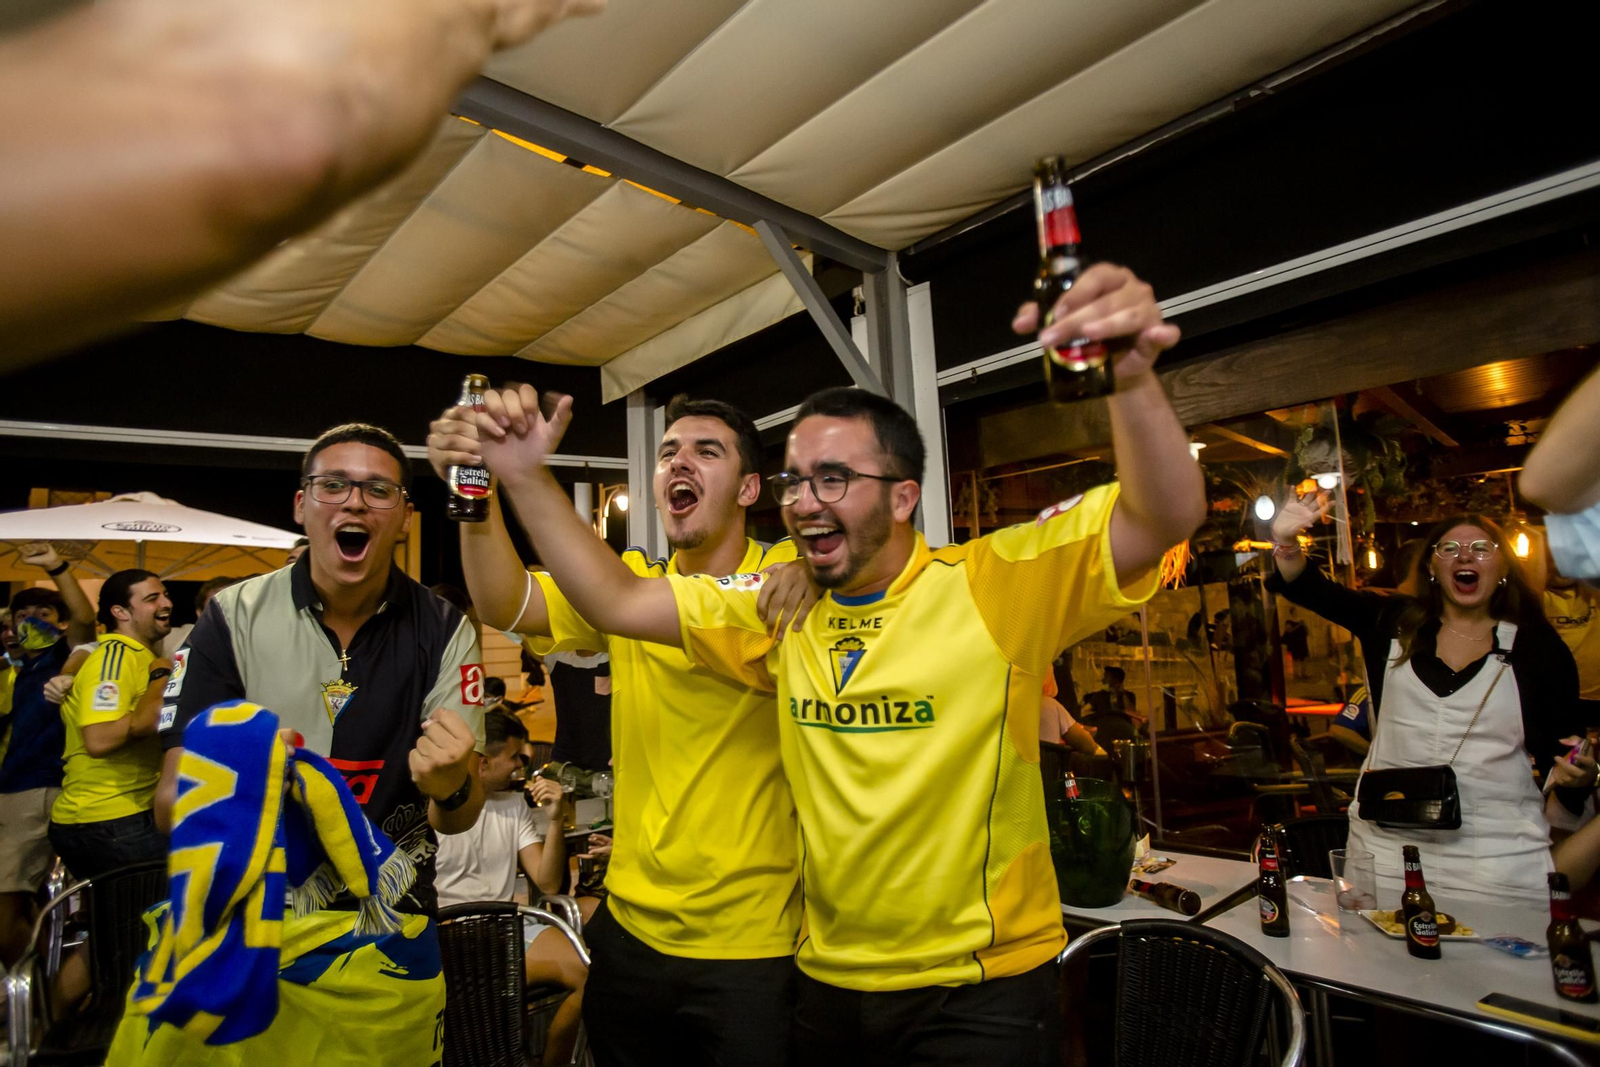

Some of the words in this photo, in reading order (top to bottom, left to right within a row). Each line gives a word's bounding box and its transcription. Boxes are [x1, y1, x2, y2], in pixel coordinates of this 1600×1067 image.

[459, 466, 490, 479] Estrella
[460, 475, 488, 487] Galicia
[828, 617, 883, 629] KELME
